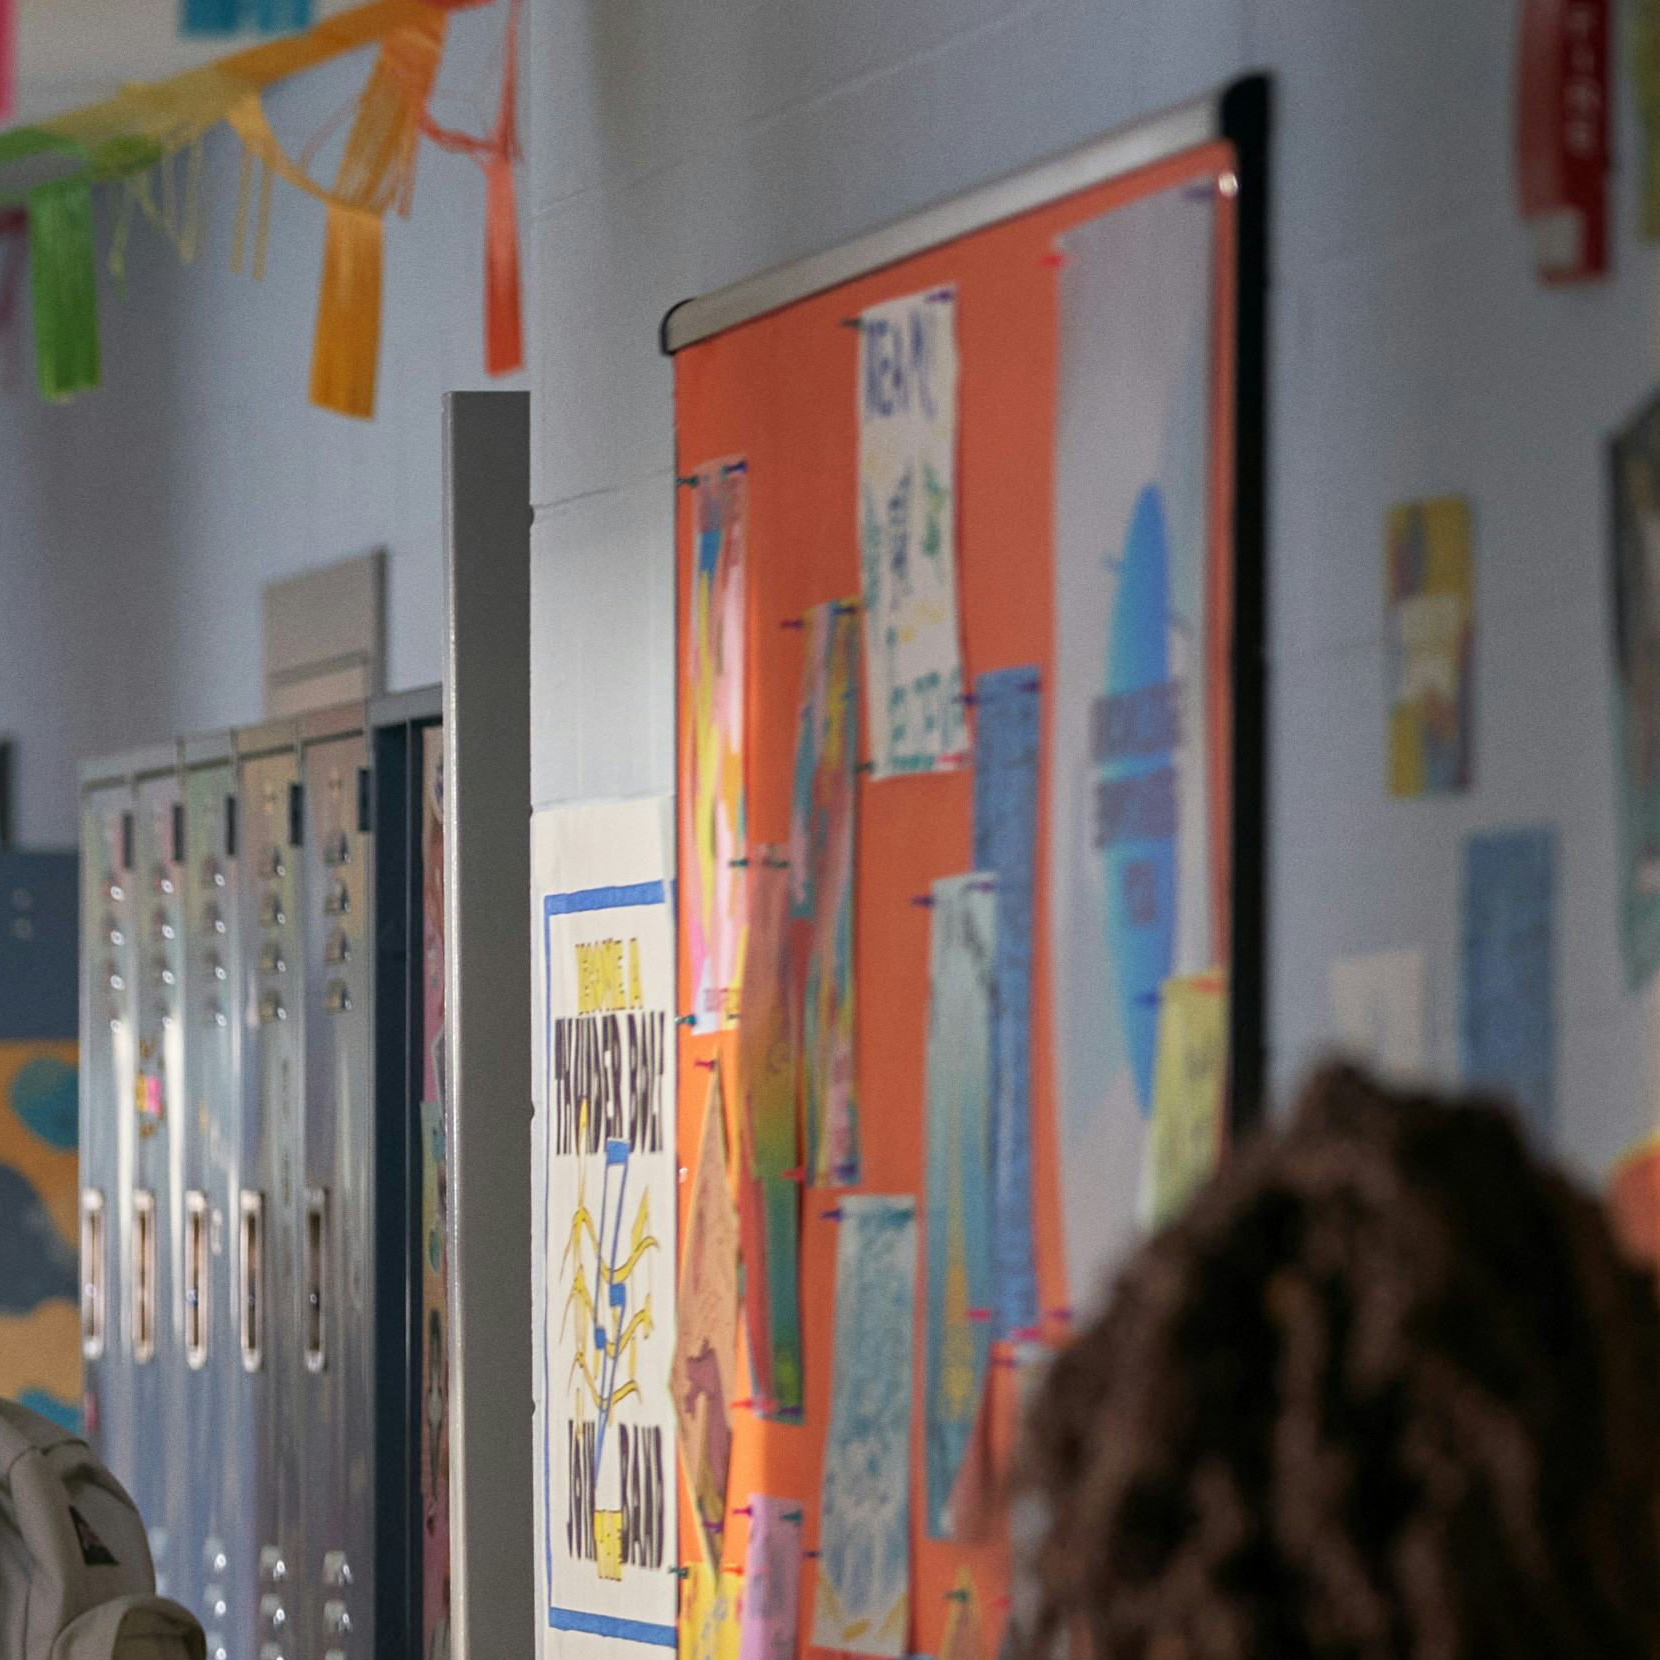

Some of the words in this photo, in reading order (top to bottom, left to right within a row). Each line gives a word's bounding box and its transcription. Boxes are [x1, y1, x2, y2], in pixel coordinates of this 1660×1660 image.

[574, 937, 626, 1015] BECOME
[628, 936, 643, 1010] A
[554, 1013, 623, 1156] THUNDER
[627, 1009, 665, 1155] BOLT
[567, 1420, 598, 1563] JOIN
[619, 1421, 665, 1569] BAND
